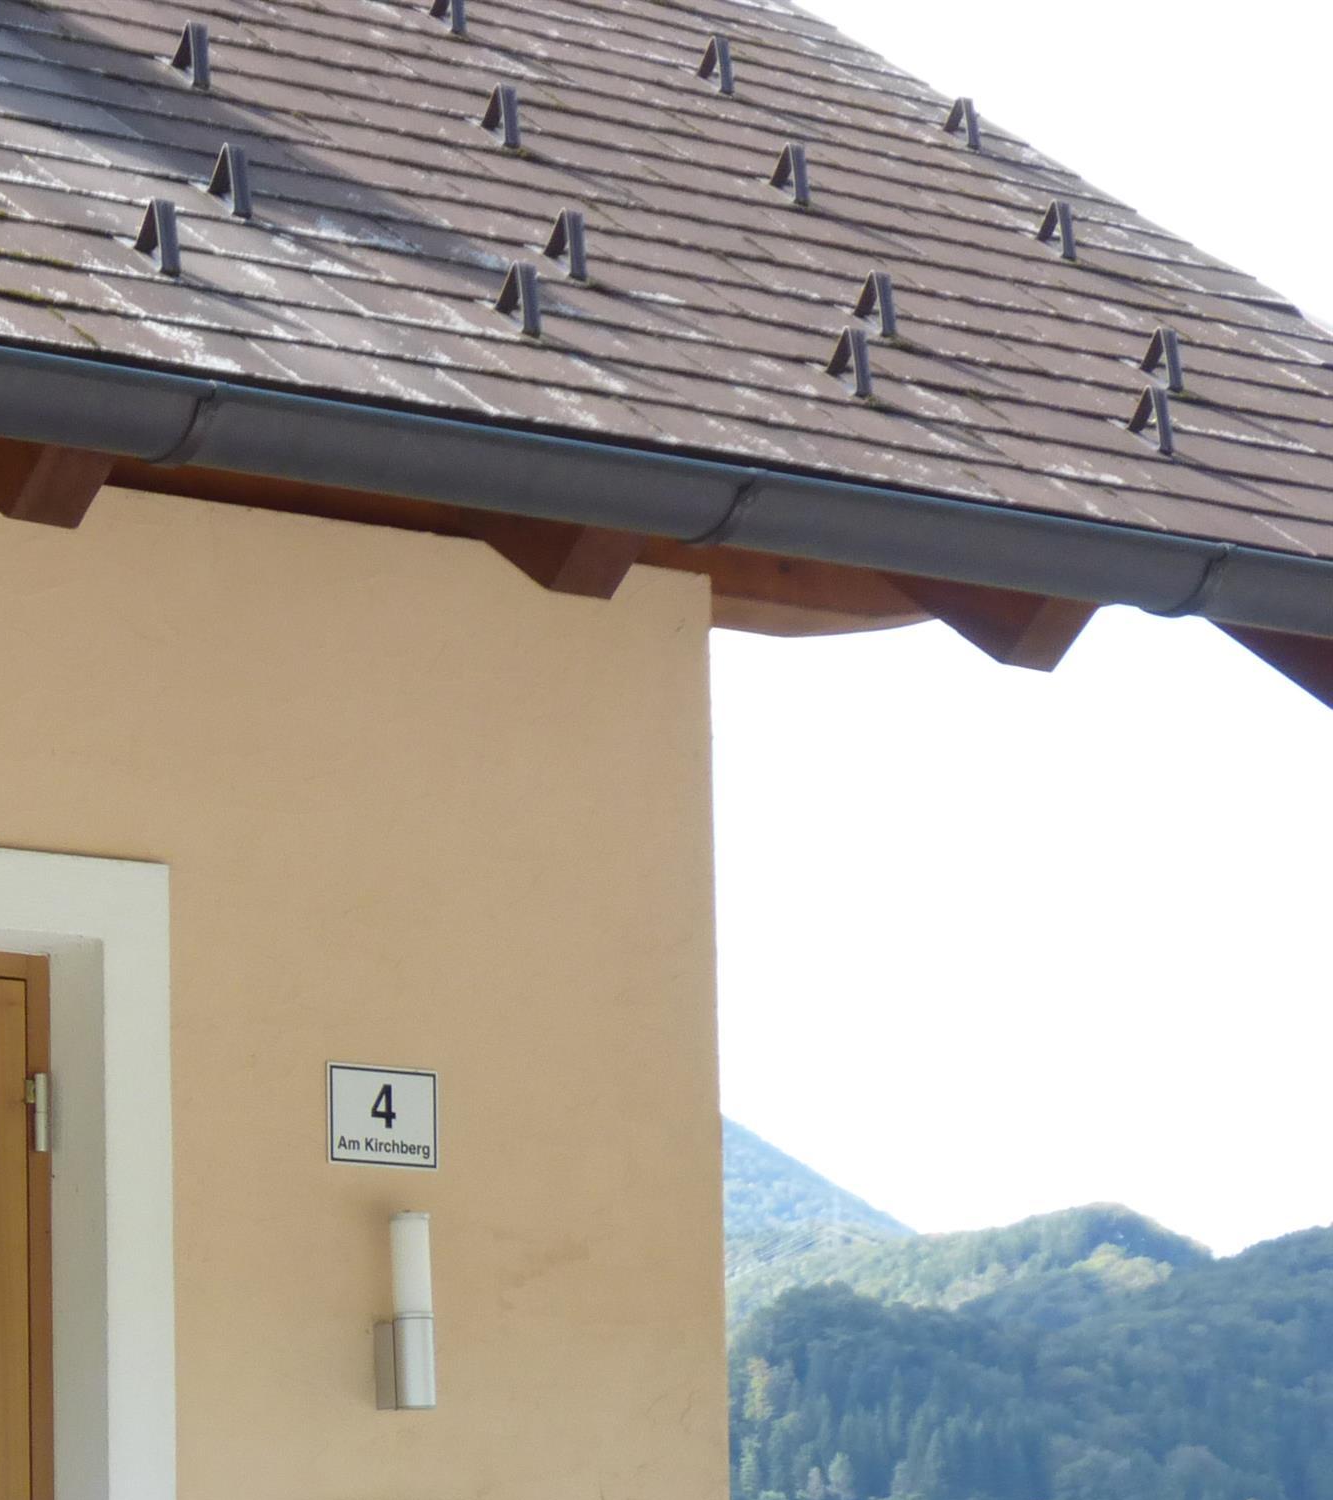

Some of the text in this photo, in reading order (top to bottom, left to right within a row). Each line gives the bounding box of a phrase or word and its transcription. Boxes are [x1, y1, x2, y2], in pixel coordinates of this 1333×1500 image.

[371, 1084, 396, 1129] 4
[338, 1136, 430, 1159] Am Kirchberg
